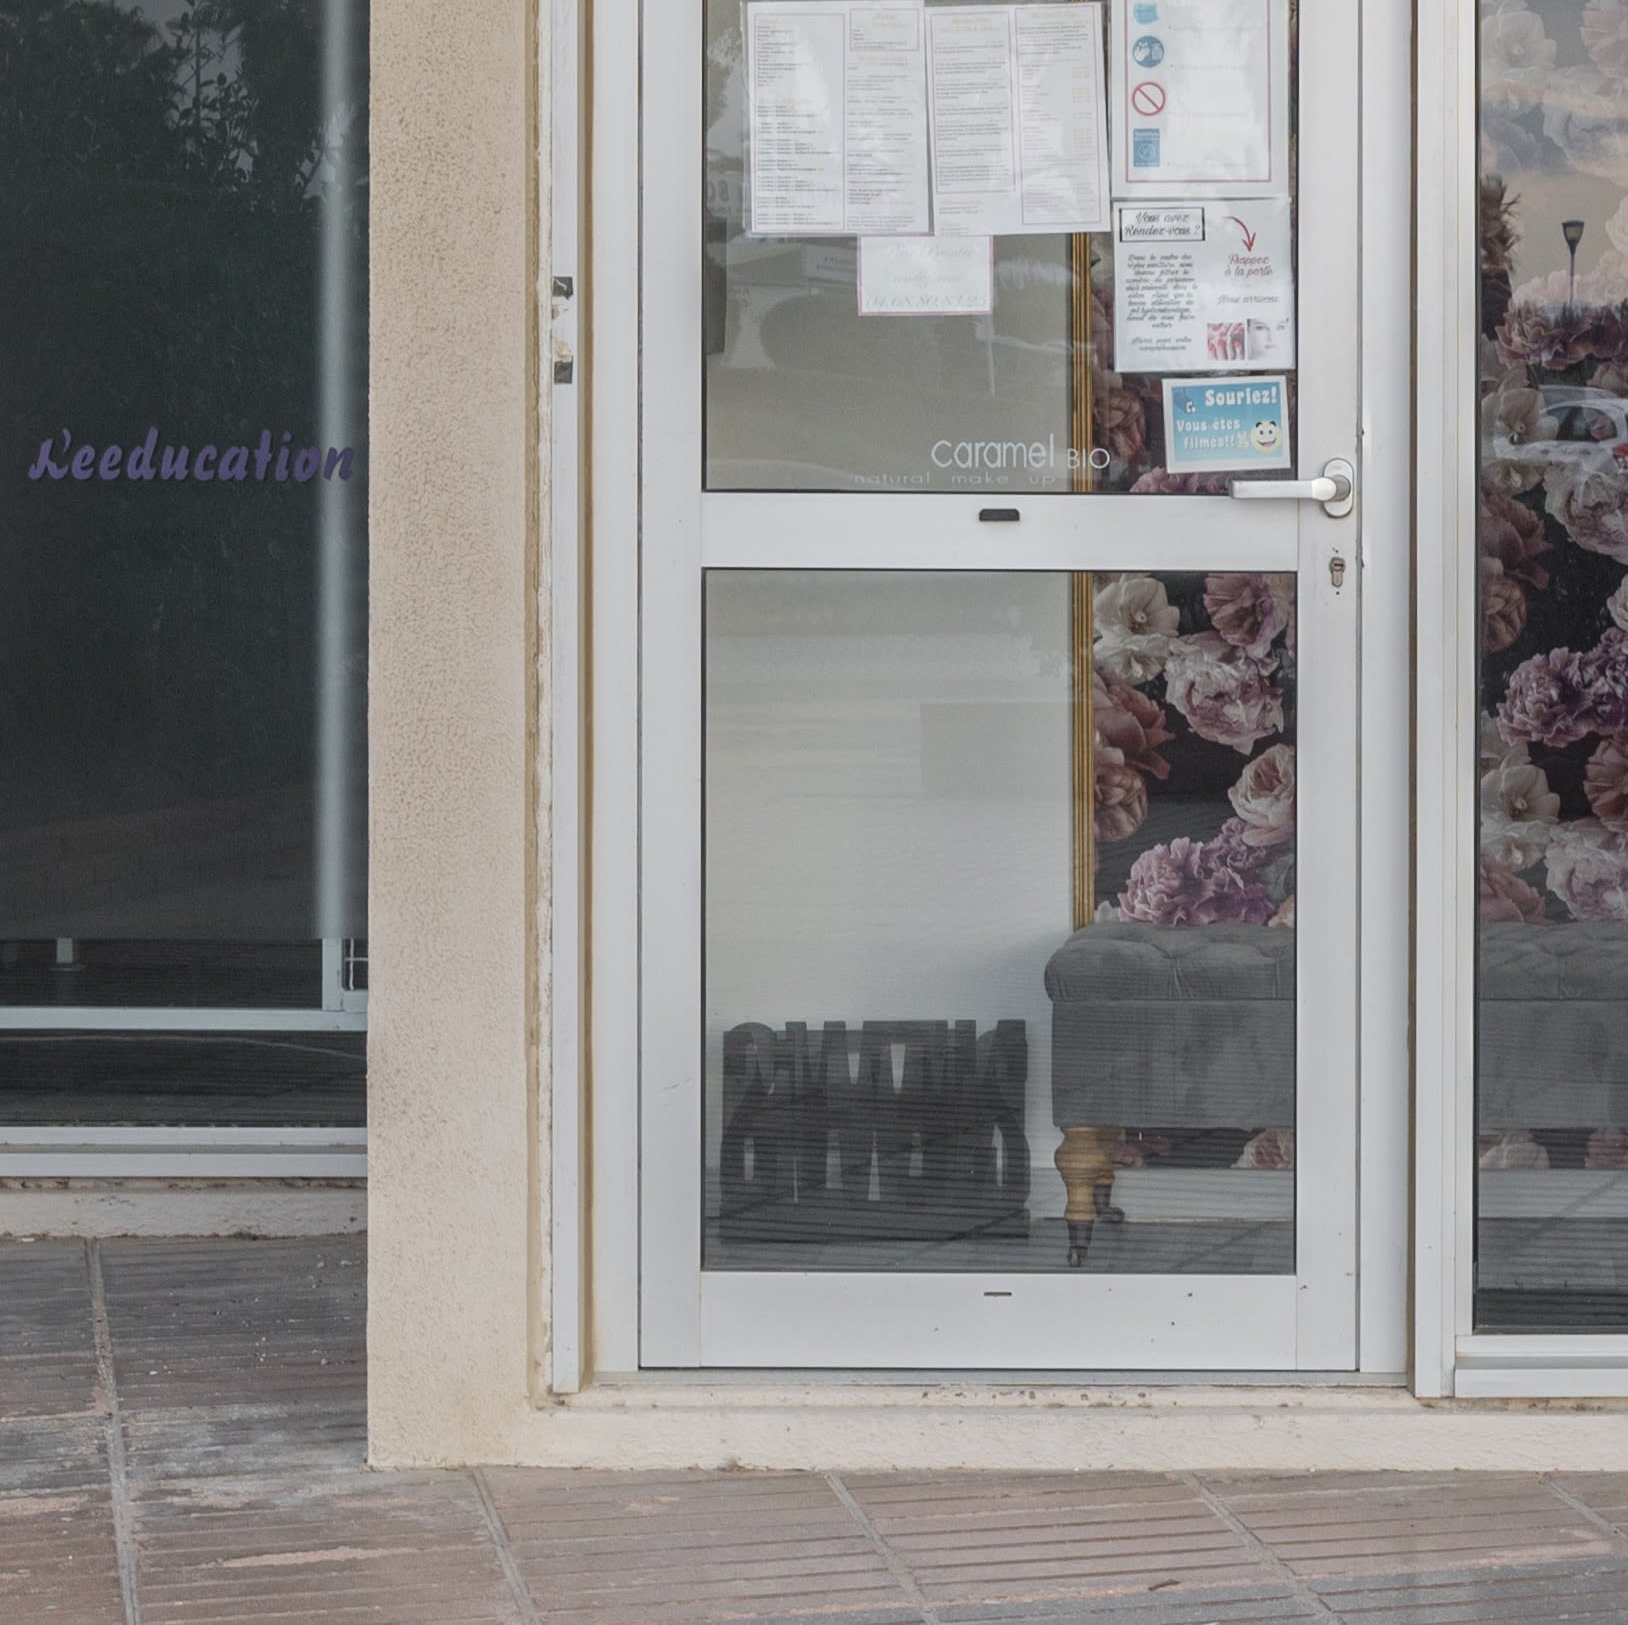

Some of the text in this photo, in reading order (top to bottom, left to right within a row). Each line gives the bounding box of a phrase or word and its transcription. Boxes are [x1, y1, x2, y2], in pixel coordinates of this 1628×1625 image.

[1135, 211, 1190, 224] Vous avez
[1124, 225, 1192, 237] Rendez-vous
[1204, 386, 1278, 408] Souriez!
[1176, 417, 1241, 433] Vous êtes
[930, 432, 1111, 470] Caramel BIO
[853, 471, 1057, 489] natural make up
